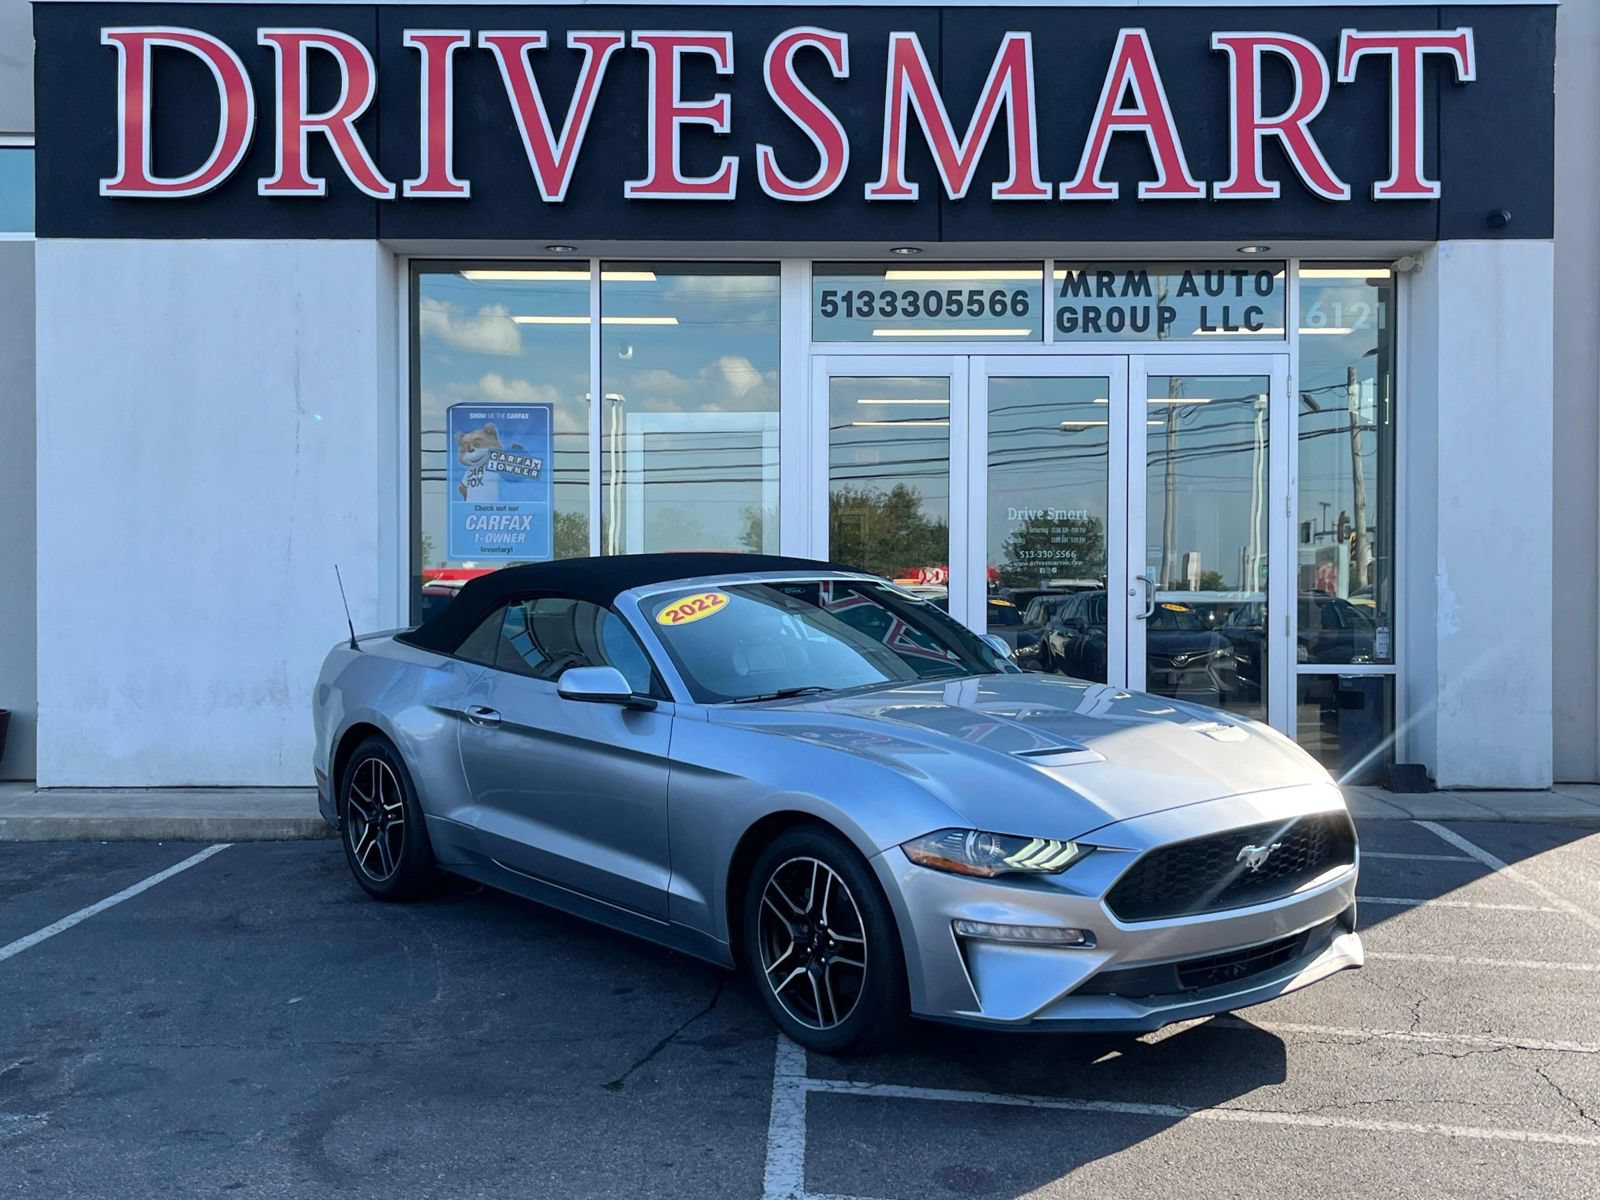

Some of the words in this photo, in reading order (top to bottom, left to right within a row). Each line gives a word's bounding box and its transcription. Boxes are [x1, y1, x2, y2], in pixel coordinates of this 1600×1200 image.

[100, 26, 1476, 203] DRIVESMART
[1060, 270, 1153, 298] MRM
[1176, 270, 1275, 297] AUTO
[820, 290, 1030, 318] 5133305566
[1056, 305, 1177, 333] GROUP
[1200, 305, 1264, 332] LLC
[506, 412, 529, 420] CARFAX
[490, 451, 542, 470] CARFAX
[474, 504, 494, 512] Check
[1007, 506, 1044, 520] Drive
[1047, 507, 1089, 521] Smart
[465, 514, 533, 531] CARFAX
[474, 532, 526, 544] 1-OWNER
[665, 594, 724, 624] 2022
